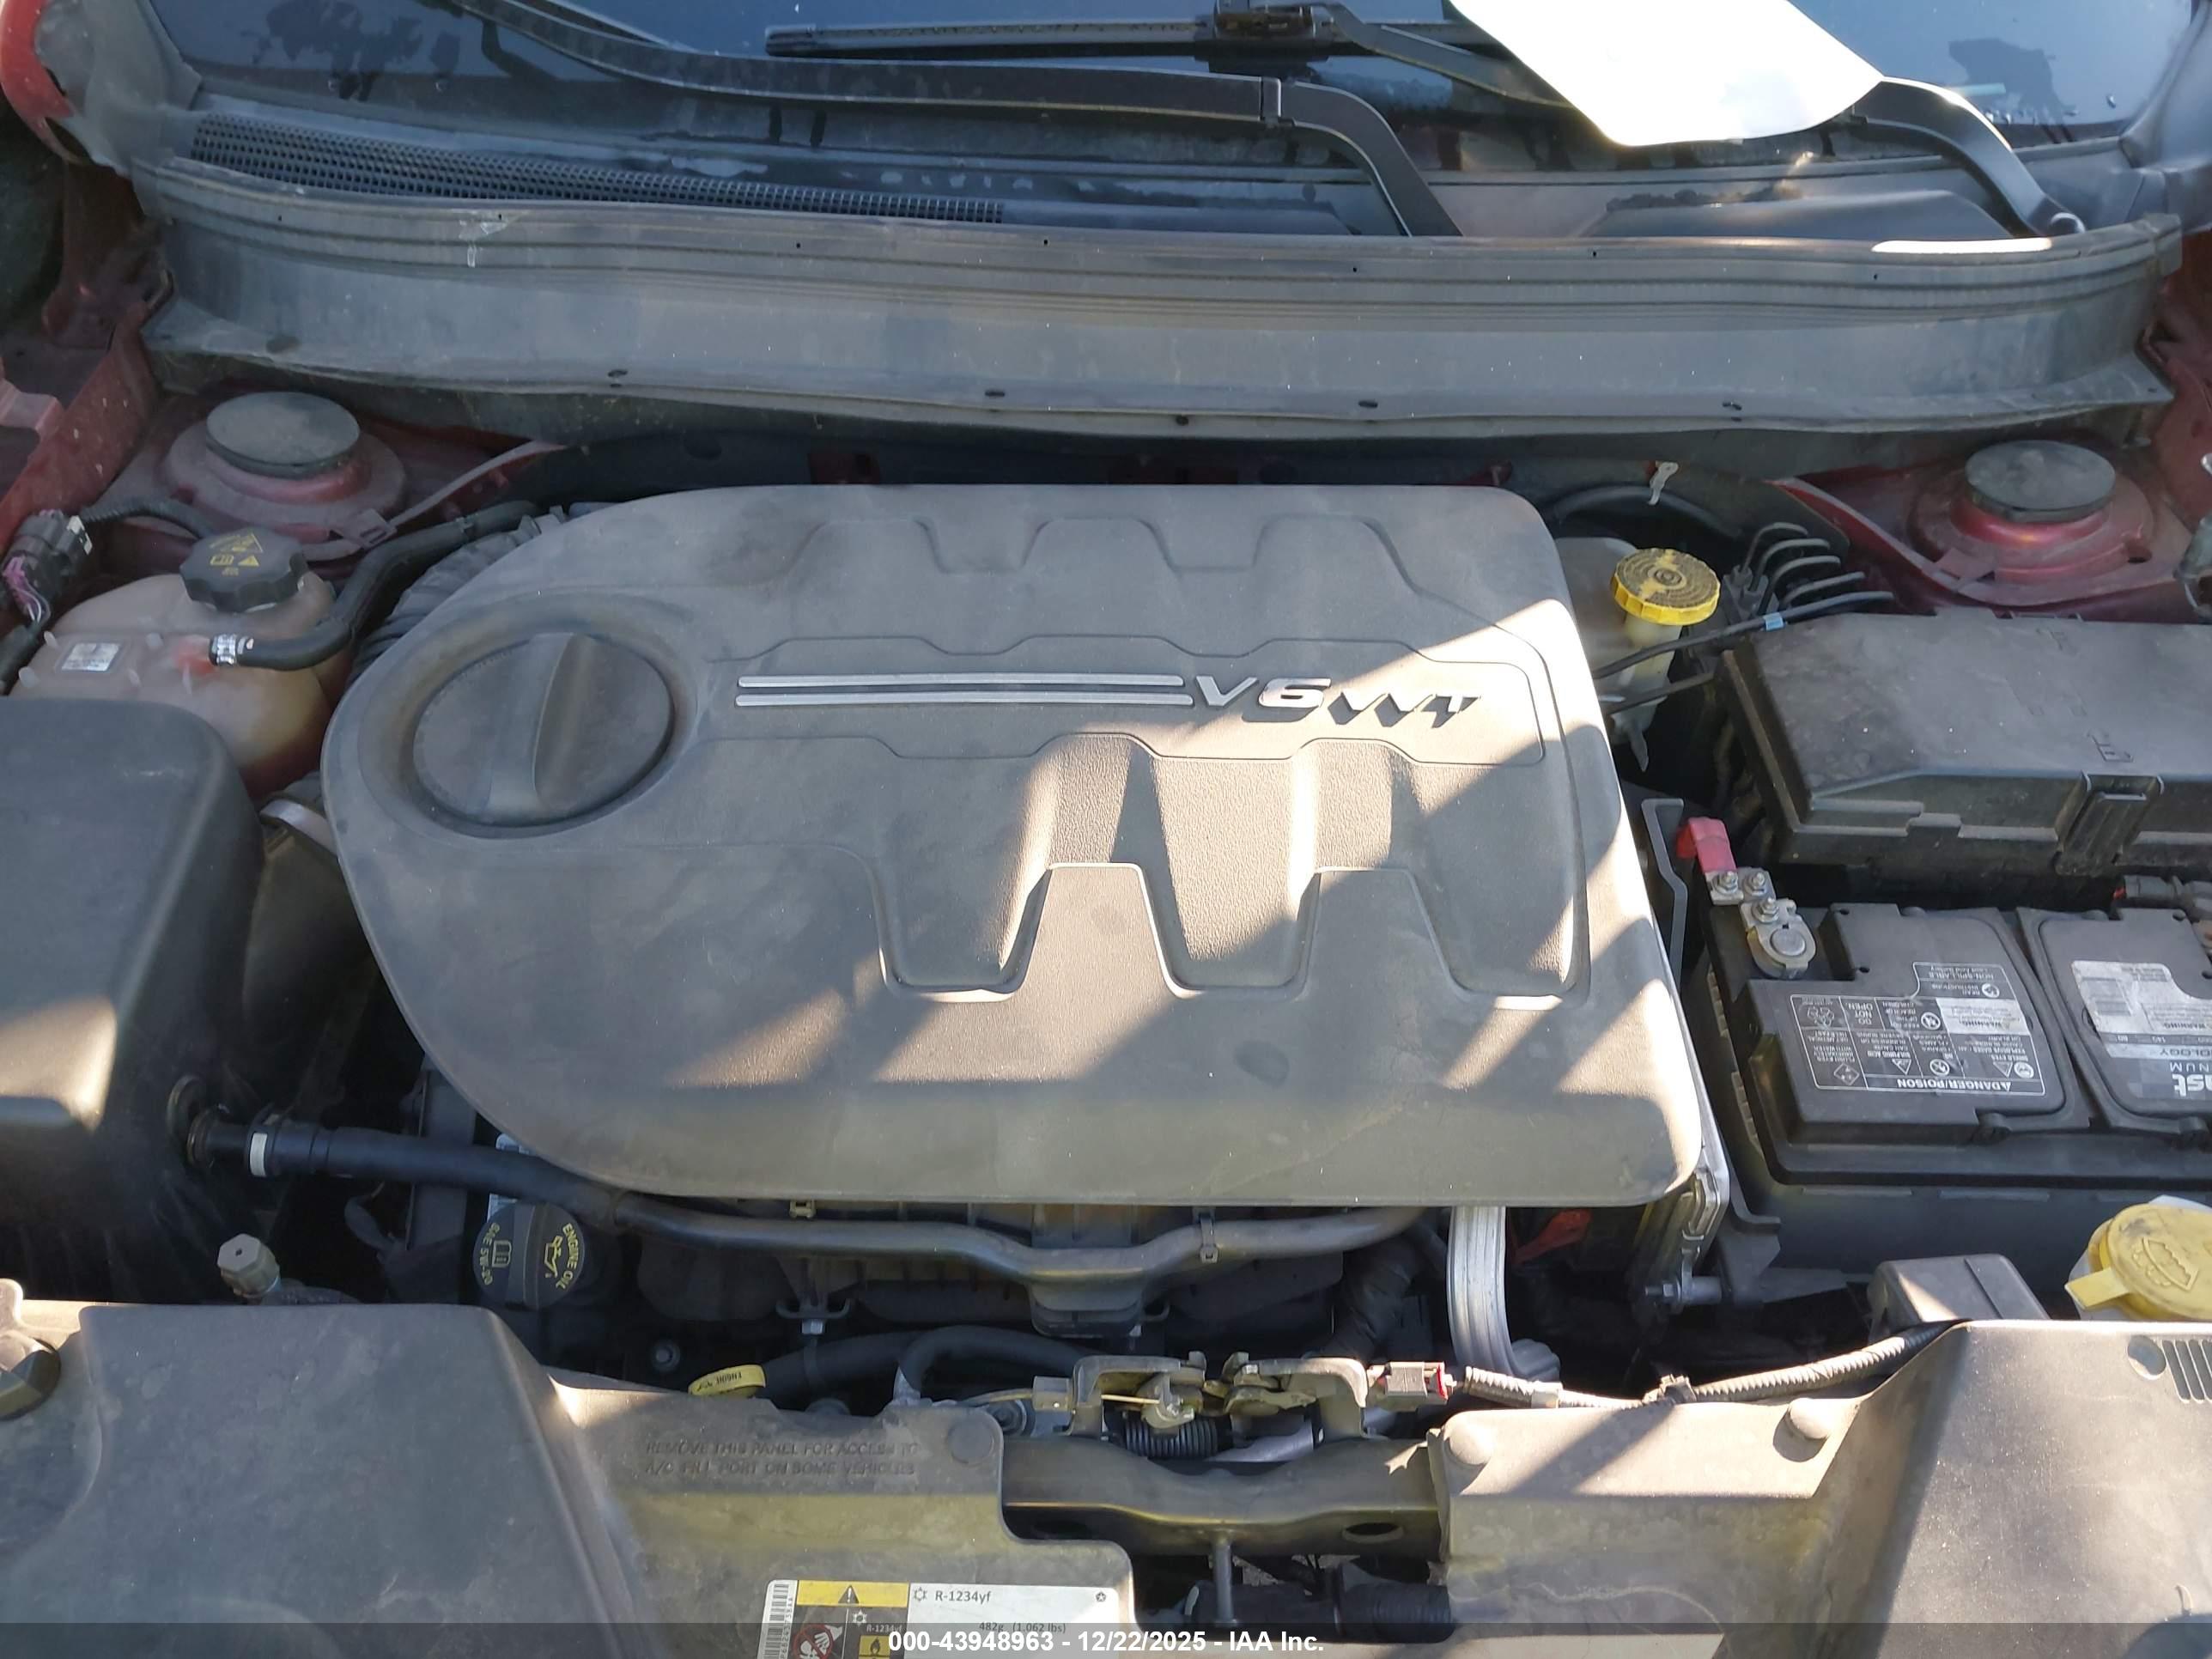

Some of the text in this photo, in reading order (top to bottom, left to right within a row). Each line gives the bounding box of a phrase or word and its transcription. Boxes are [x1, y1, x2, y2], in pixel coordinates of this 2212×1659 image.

[1196, 675, 1331, 708] V6
[1897, 1079, 2002, 1091] DANGER/POISON
[562, 1222, 579, 1269] ENGINE
[715, 1442, 746, 1455] THIS
[751, 1442, 798, 1455] PANEL
[804, 1442, 836, 1455] FOR
[719, 1460, 757, 1474] PORT
[936, 1591, 992, 1605] R-1234yf
[979, 1622, 1004, 1632] 482g
[1048, 1622, 1066, 1633] lbs)
